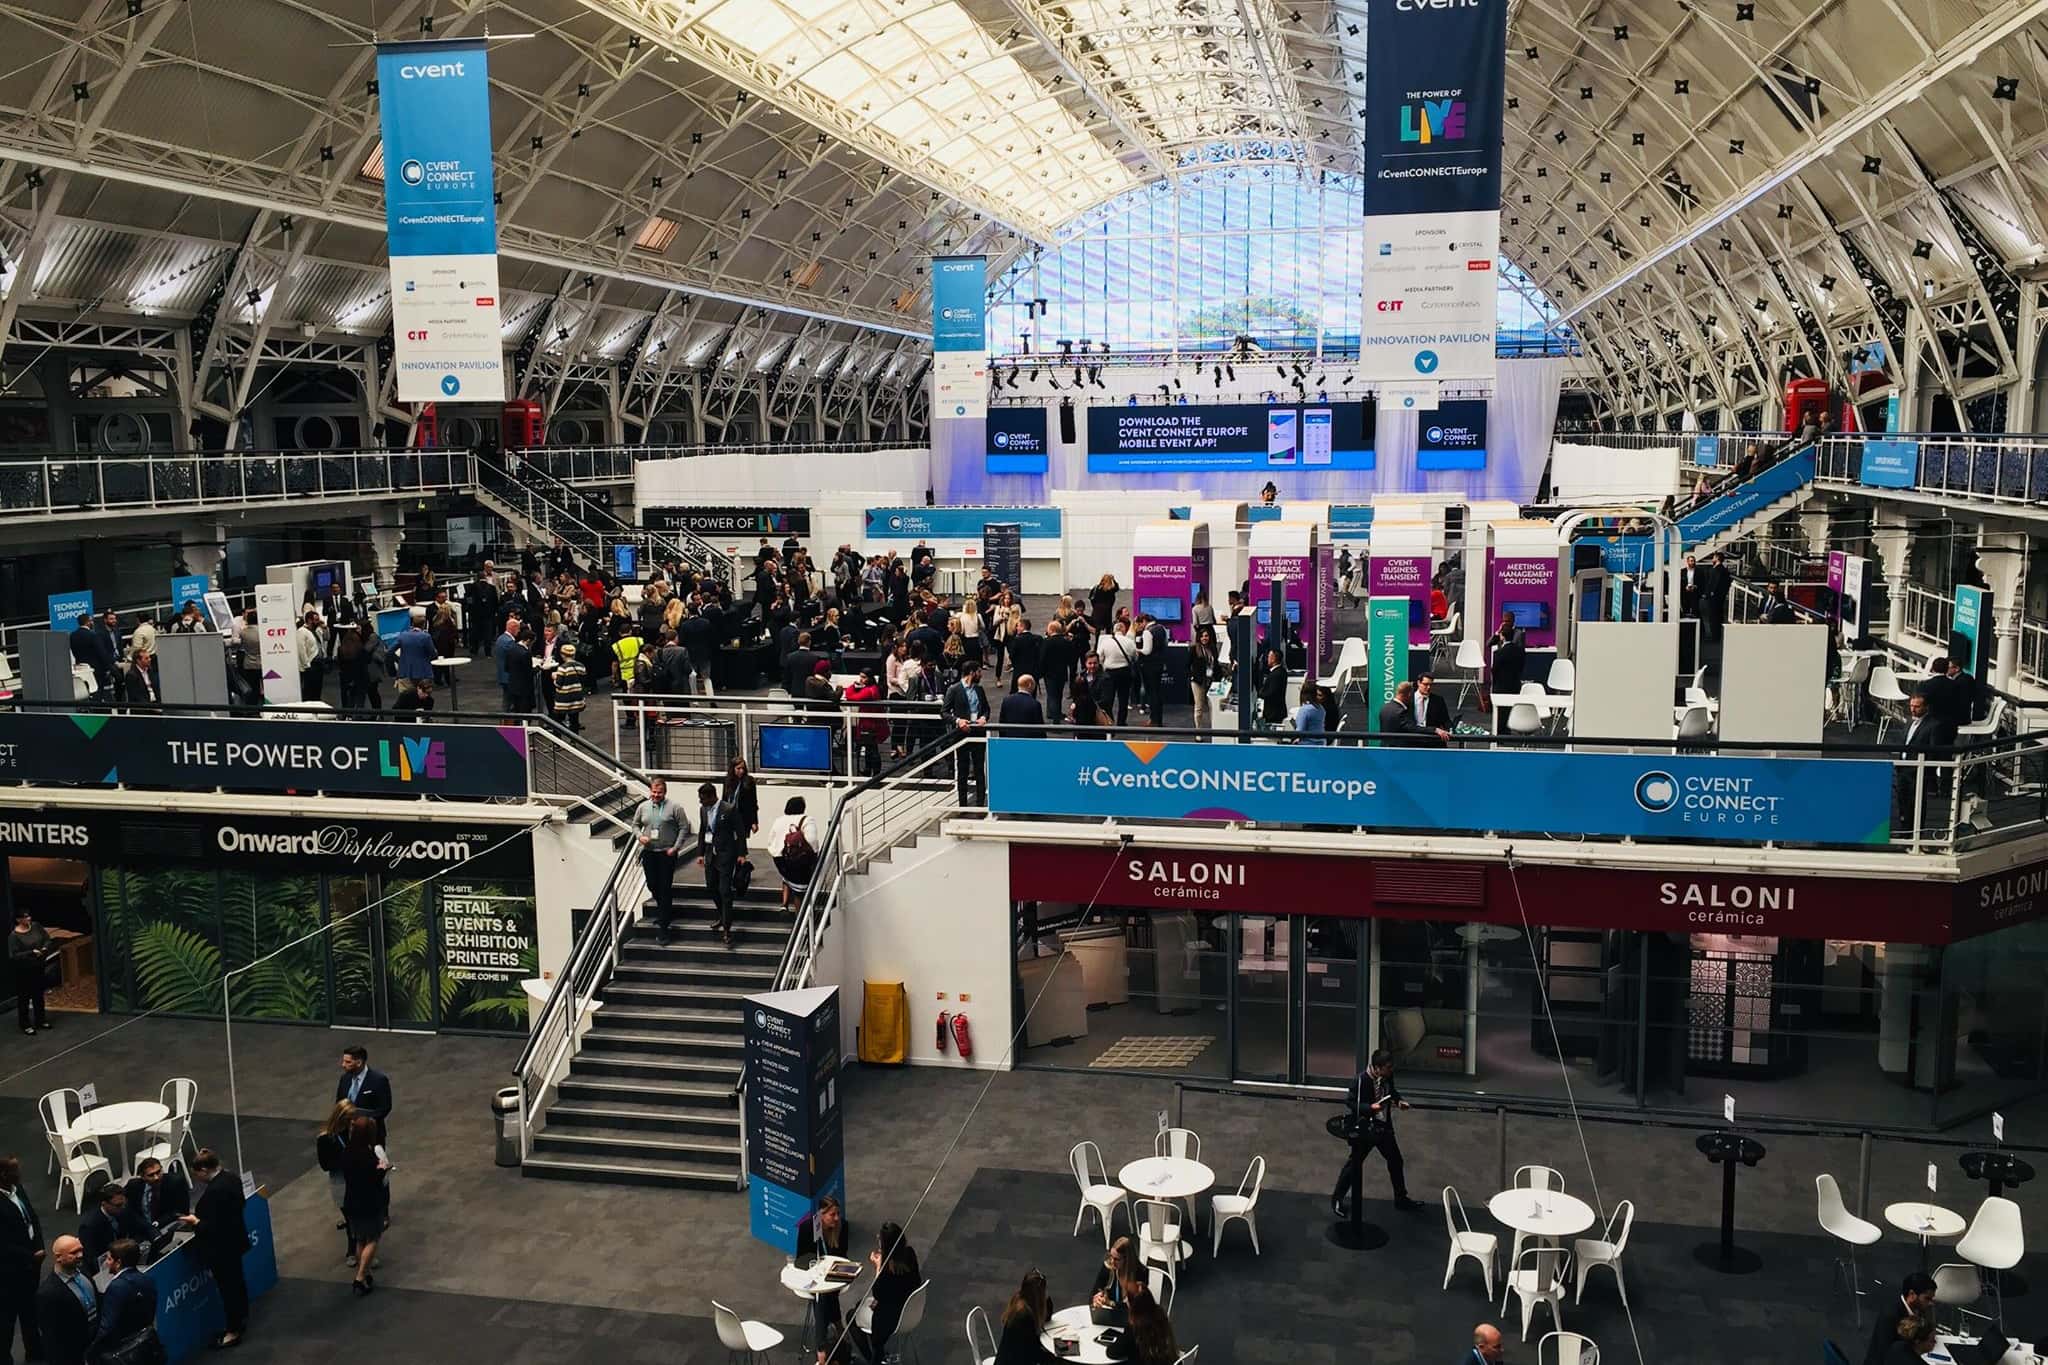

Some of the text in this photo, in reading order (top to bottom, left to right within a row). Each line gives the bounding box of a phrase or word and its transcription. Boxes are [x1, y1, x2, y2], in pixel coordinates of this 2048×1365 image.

[400, 61, 465, 79] cvent
[1406, 89, 1462, 99] THE POWER OF
[1400, 99, 1466, 144] LIVE
[426, 160, 460, 171] CVENT
[426, 171, 475, 182] CONNECT
[1378, 166, 1488, 179] #CventCONNECTEurope
[427, 183, 475, 191] EUROPE
[399, 214, 485, 225] #CventCONNECTEurope
[943, 263, 975, 272] cvent
[408, 330, 428, 341] CIT
[1366, 333, 1490, 345] INNOVATION PAVILION
[401, 360, 499, 370] INNOVATION PAVILION
[1119, 417, 1201, 426] DOWNLOAD THE
[1119, 427, 1248, 437] CVENT CONNECT EUROPE
[1119, 438, 1217, 448] MOBILE EVENT APP!
[664, 513, 790, 533] THE POWER OF LIVE
[1138, 565, 1187, 573] PROJECT FLEX
[54, 600, 88, 612] TECHNICAL
[267, 628, 287, 637] CIT
[1384, 634, 1395, 704] INNOVATIO
[167, 736, 447, 781] THE POWER OF LIVE
[1078, 767, 1377, 800] #CventCONNECTEurope
[1685, 777, 1753, 792] CVENT
[1684, 794, 1779, 811] CONNECT
[1683, 811, 1779, 825] EUROPE
[0, 822, 89, 846] RINTERS
[1128, 860, 1246, 885] SALONI
[443, 885, 472, 893] ON-SITE
[1154, 886, 1220, 899] cerámica
[1980, 869, 2048, 908] SALONI
[1660, 882, 1796, 910] SALONI
[444, 901, 495, 914] RETAIL
[1688, 909, 1765, 926] cerámica
[445, 917, 517, 932] EVENTS &
[445, 933, 528, 949] EXHIBITION
[446, 950, 519, 966] PRINTERS
[447, 971, 477, 980] PLEASE
[477, 973, 500, 981] COME
[767, 1015, 784, 1025] CVENT
[767, 1022, 791, 1035] CONNECT
